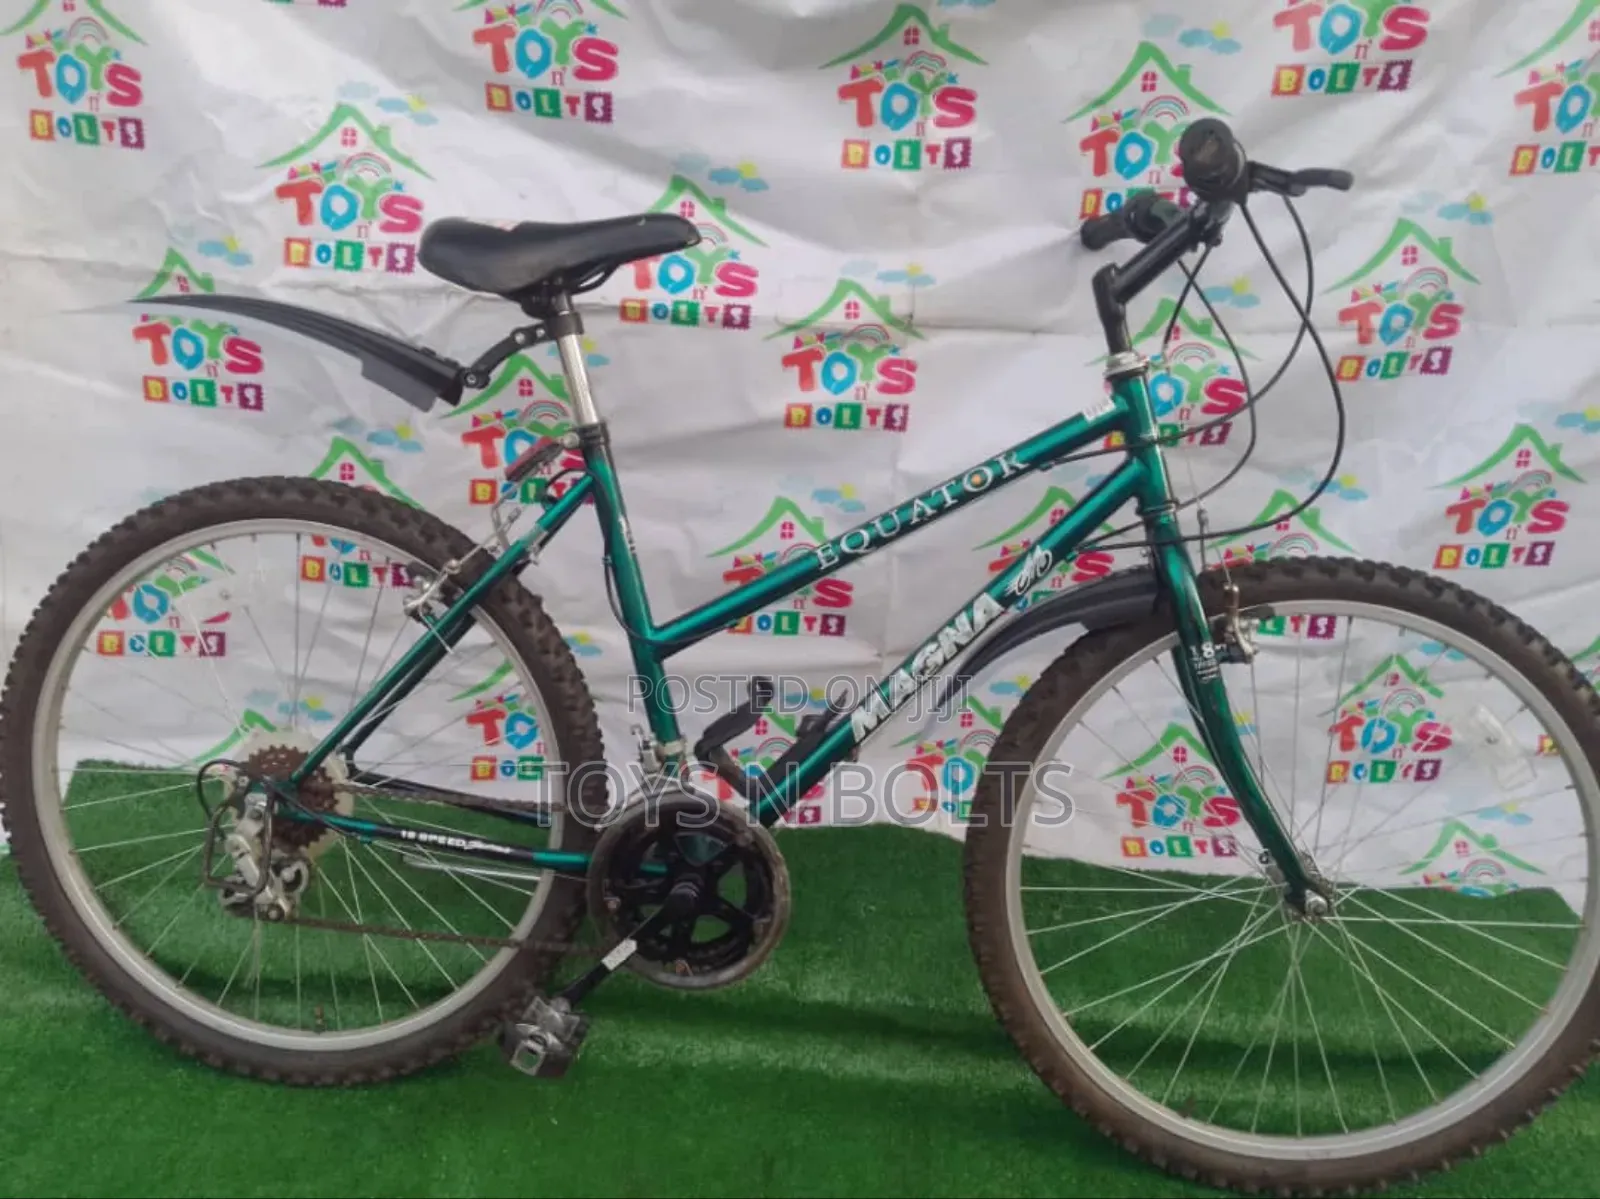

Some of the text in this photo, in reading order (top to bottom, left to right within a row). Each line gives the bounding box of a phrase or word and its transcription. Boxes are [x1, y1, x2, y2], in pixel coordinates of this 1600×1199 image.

[473, 17, 619, 82] TOYS
[1273, 0, 1430, 55] TOYS
[17, 43, 144, 107] TOYS
[1271, 59, 1415, 97] BOLTS
[485, 82, 613, 124] BOLTS
[837, 72, 978, 131] TOYS
[30, 109, 145, 150] BOLTS
[1080, 120, 1185, 181] TOY
[840, 136, 972, 171] BOLTS
[275, 174, 424, 234] TOYS
[284, 237, 416, 274] BOLTS
[620, 244, 759, 298] TOYS
[619, 298, 751, 331] BOLTS
[1338, 291, 1464, 346] TOYS
[132, 317, 265, 375] TOYS
[782, 343, 918, 396] TOYS
[1336, 346, 1453, 383] BOLTS
[143, 375, 264, 412] BOLTS
[784, 402, 910, 432] BOLTS
[816, 450, 1030, 571] EQUATOR
[1445, 489, 1570, 538] TOYS
[1432, 540, 1556, 570] BOLTS
[850, 592, 1006, 743] MAGNA
[1328, 709, 1453, 754] TOYS
[1115, 785, 1241, 828] TOYS
[418, 832, 467, 847] SPEED
